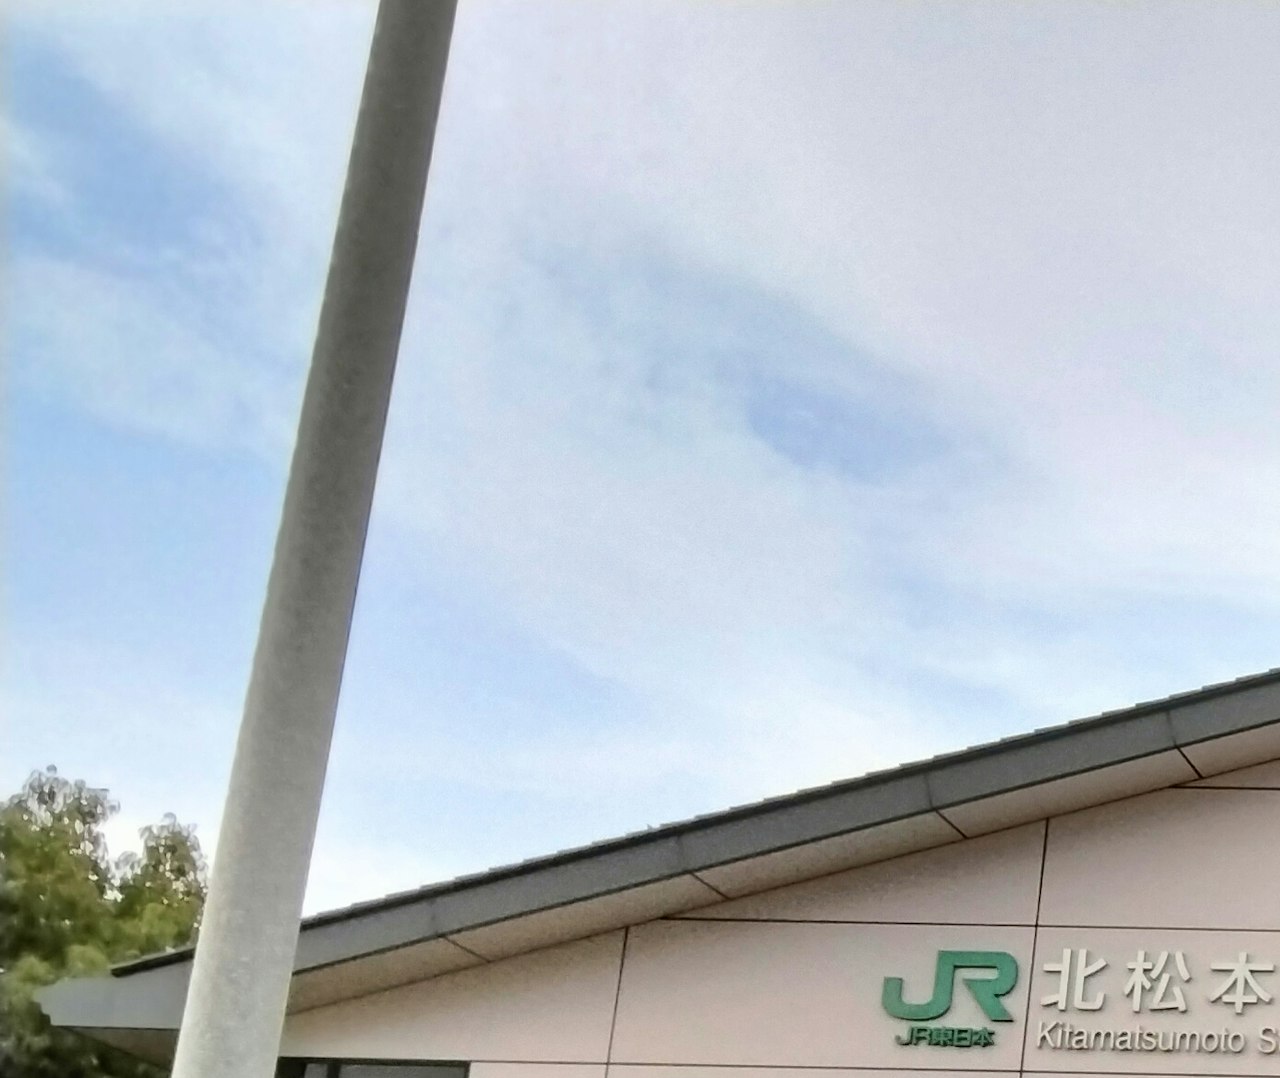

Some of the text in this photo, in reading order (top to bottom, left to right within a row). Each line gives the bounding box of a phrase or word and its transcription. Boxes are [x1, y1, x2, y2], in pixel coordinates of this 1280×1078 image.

[881, 949, 1019, 1023] JR
[894, 1025, 996, 1049] JR東日本
[1036, 1021, 1246, 1054] Kitamatsumoto
